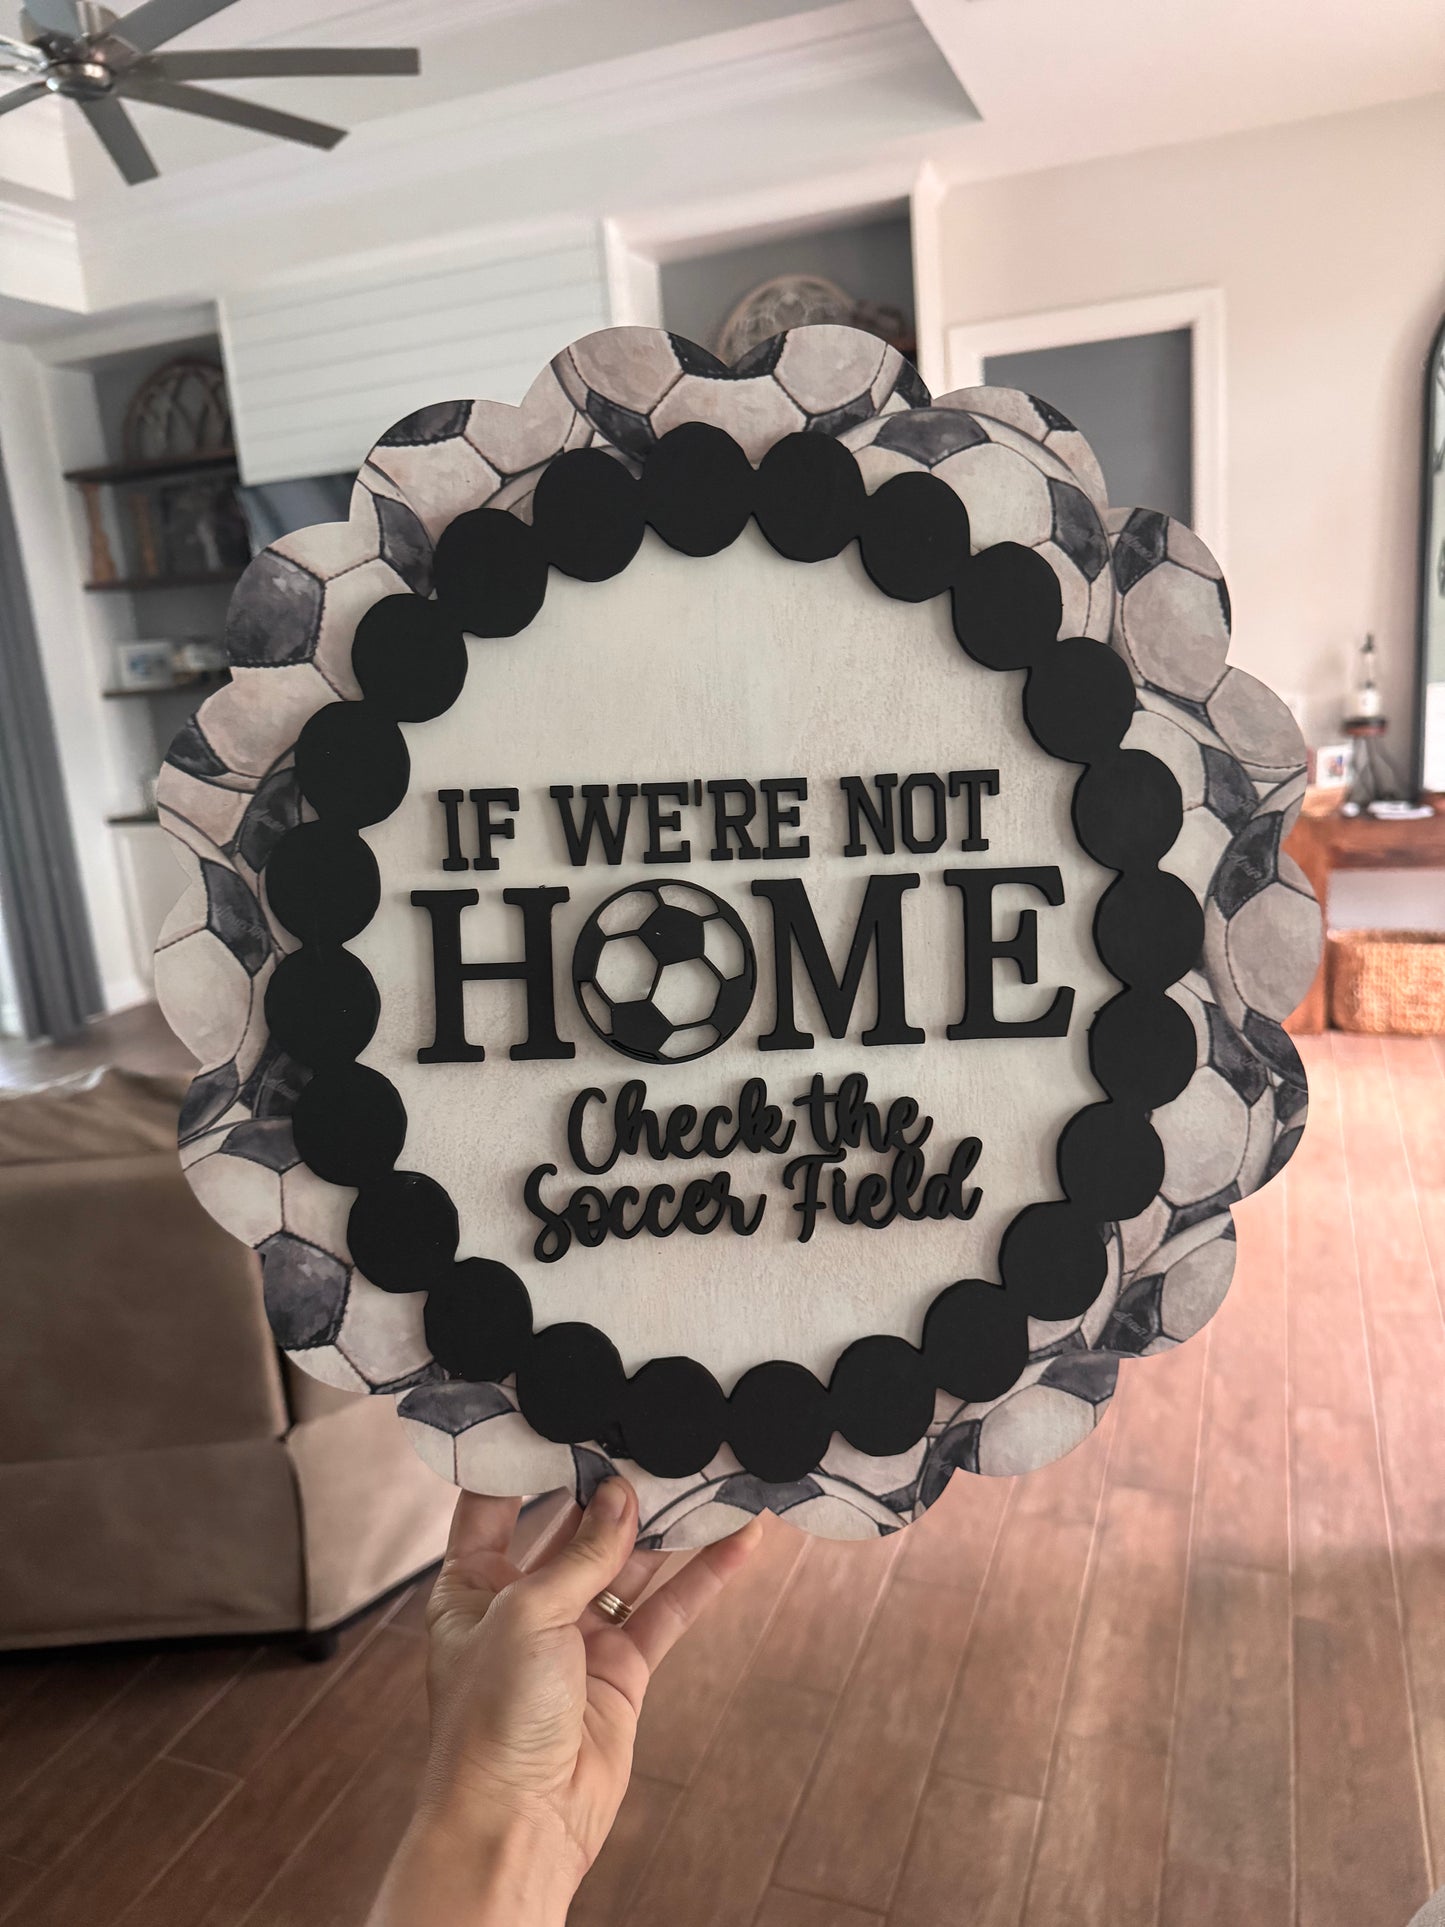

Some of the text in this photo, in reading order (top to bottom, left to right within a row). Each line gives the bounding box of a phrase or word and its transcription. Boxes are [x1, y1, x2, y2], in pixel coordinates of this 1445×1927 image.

[438, 769, 1000, 871] IF WE'RE NOT
[567, 1072, 934, 1176] Check the
[523, 1137, 984, 1264] Soccer Field
